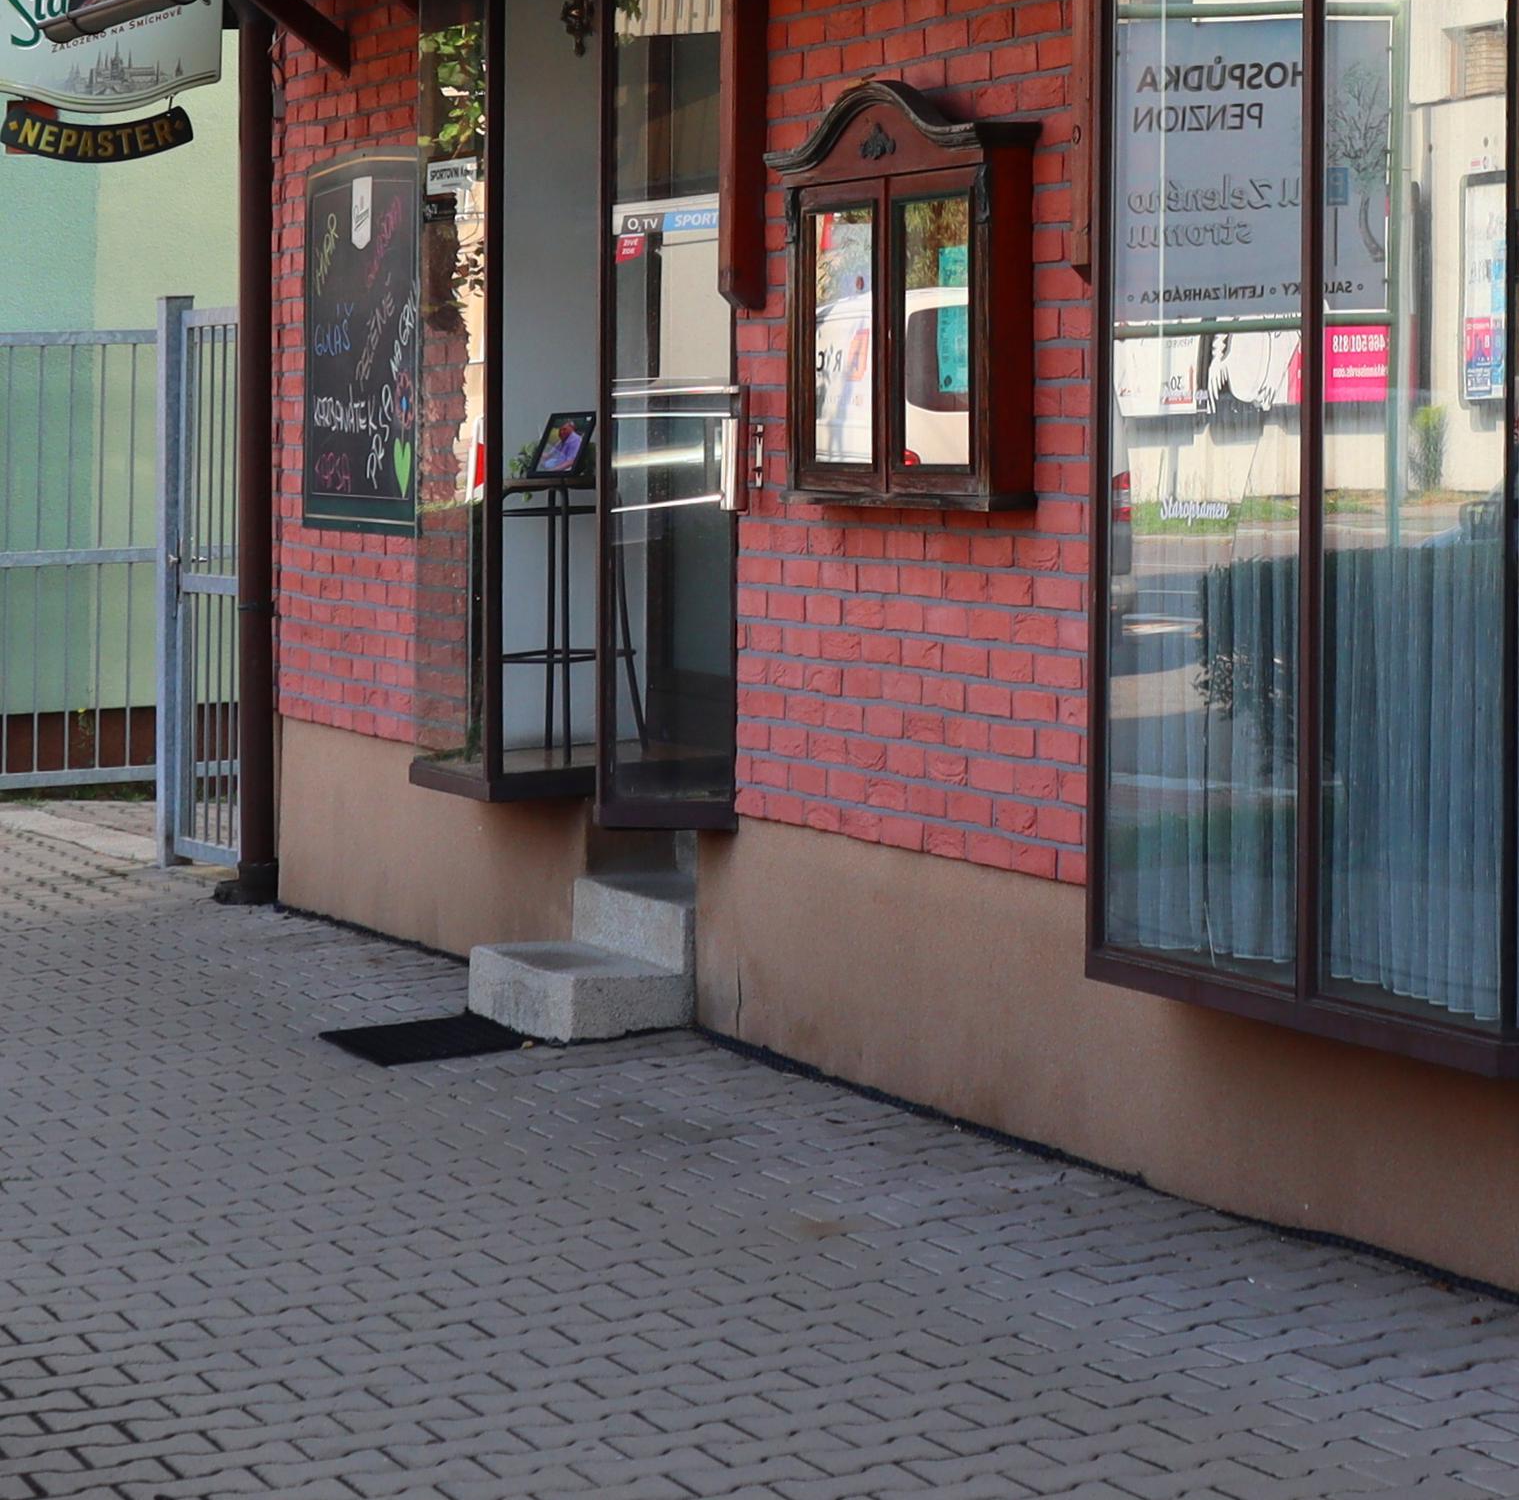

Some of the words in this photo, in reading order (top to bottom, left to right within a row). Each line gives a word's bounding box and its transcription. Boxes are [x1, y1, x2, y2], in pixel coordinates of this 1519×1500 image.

[111, 26, 125, 35] NA
[17, 118, 176, 157] NEPASTER
[643, 219, 658, 229] TV
[674, 213, 719, 227] SPORT
[1161, 496, 1230, 527] Staropramen
